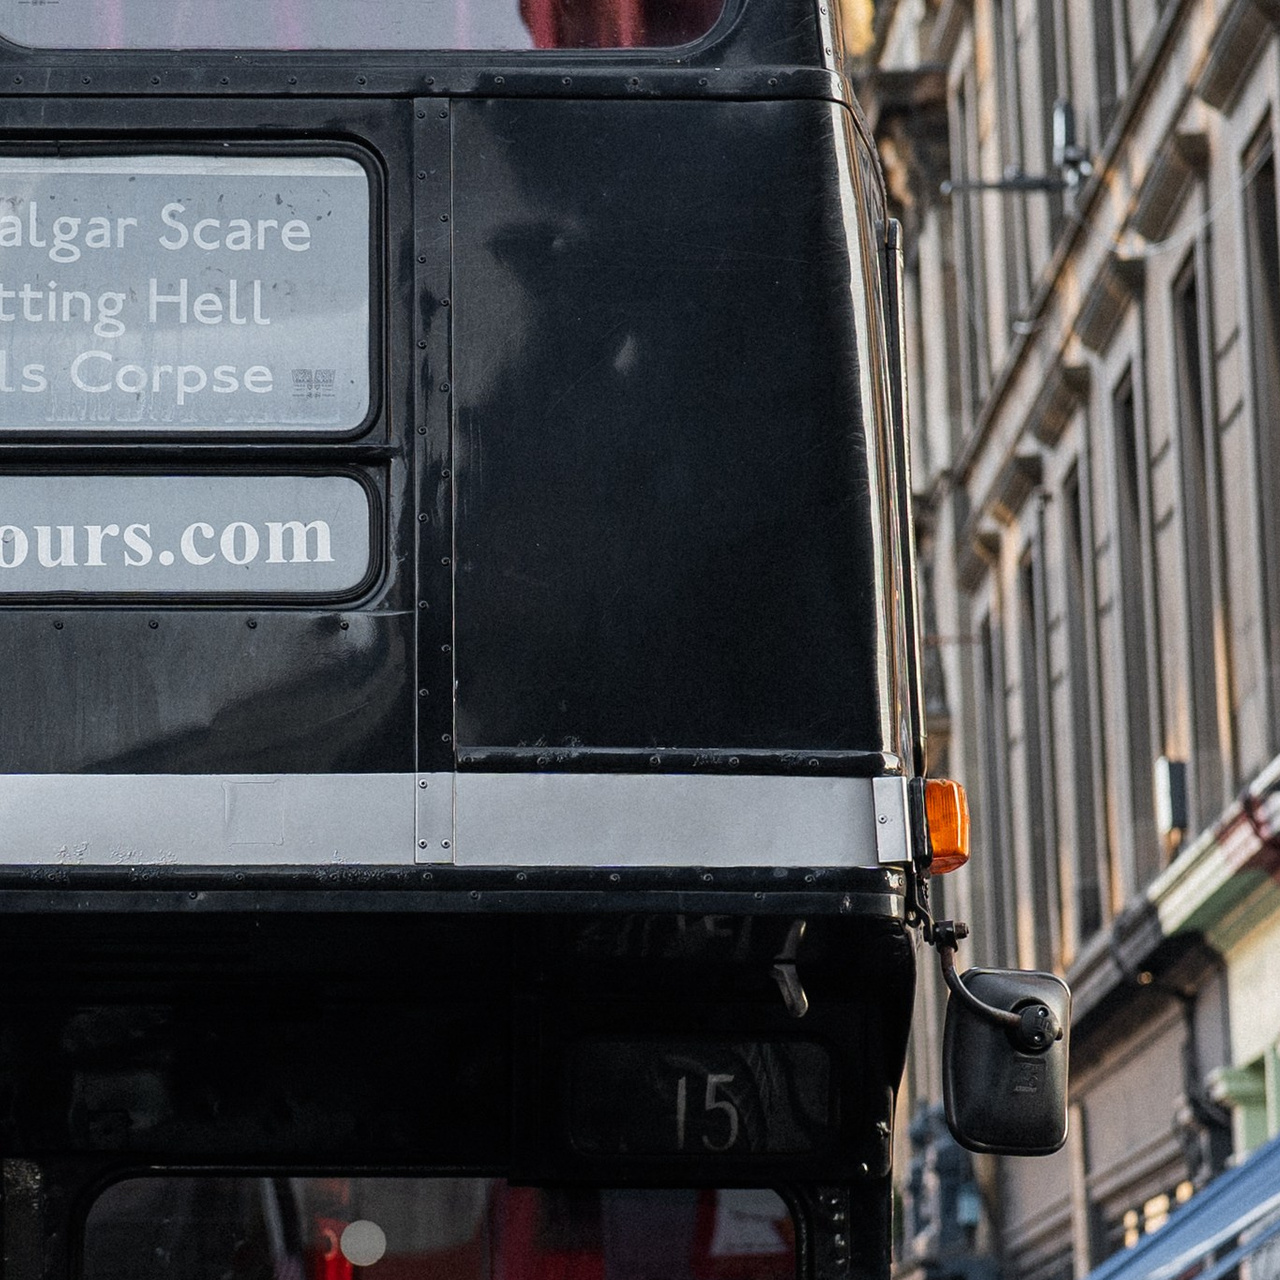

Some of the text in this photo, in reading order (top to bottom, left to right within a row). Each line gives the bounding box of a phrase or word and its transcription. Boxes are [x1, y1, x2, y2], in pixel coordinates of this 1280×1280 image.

[158, 202, 312, 252] Scare
[149, 277, 271, 325] Hell
[70, 350, 274, 405] Corpse
[675, 1073, 739, 1151] 15
